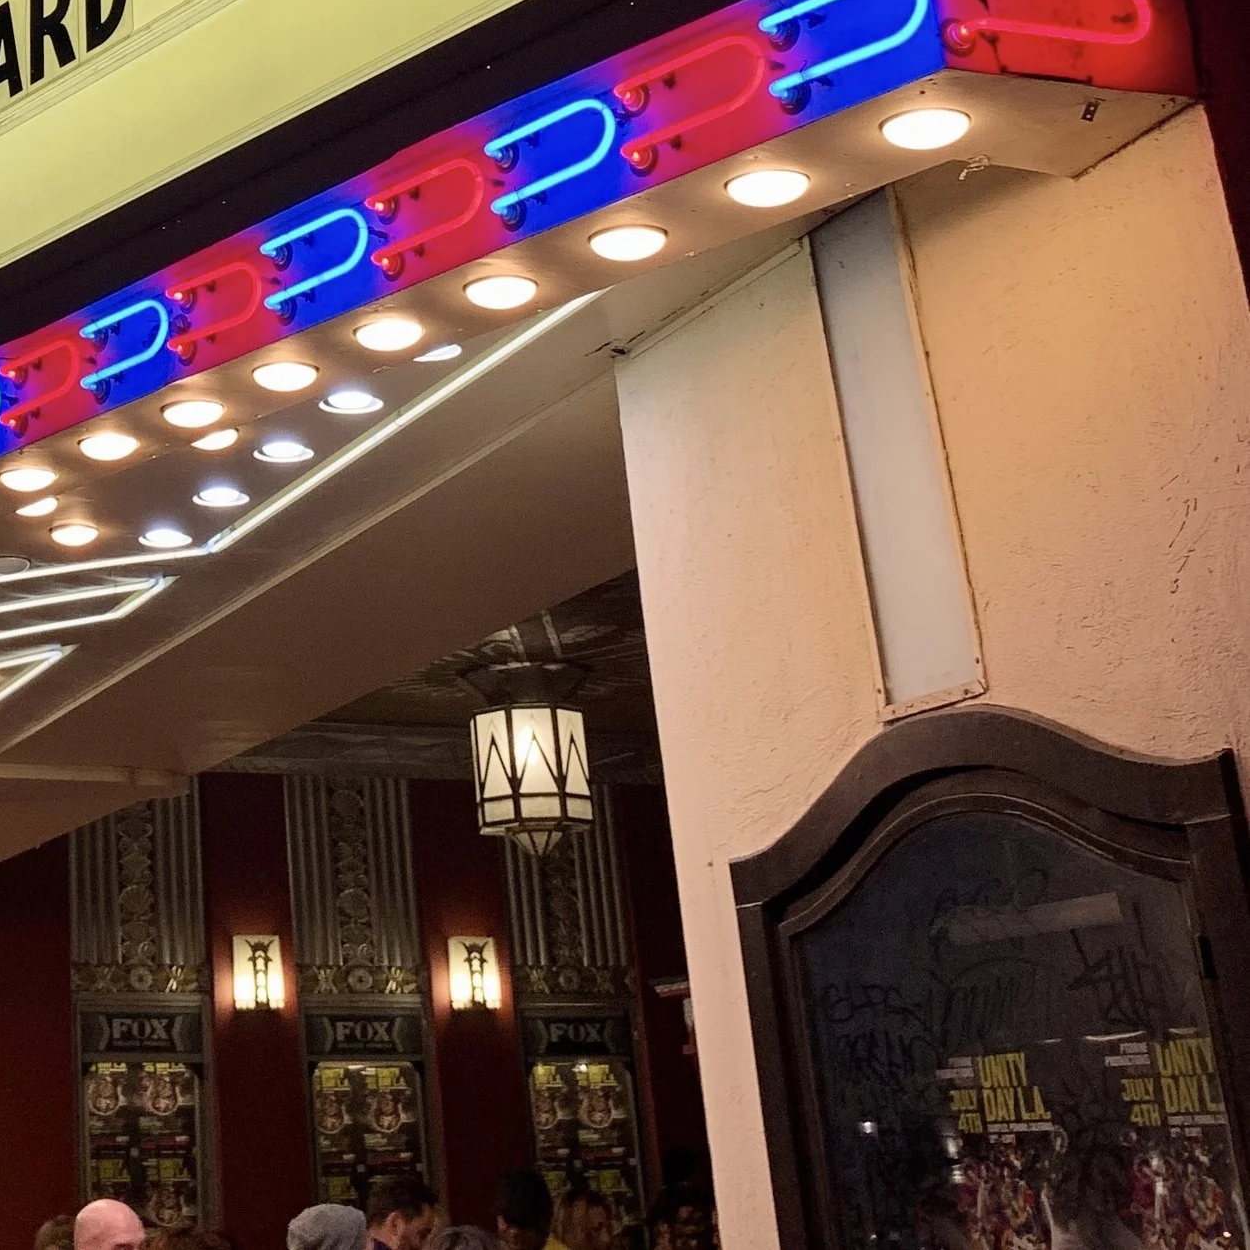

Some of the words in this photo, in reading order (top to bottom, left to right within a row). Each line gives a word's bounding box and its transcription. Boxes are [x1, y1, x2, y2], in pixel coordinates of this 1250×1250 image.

[112, 1018, 168, 1039] FOX
[336, 1021, 390, 1041] FOX
[550, 1023, 601, 1042] FOX
[1153, 1038, 1215, 1076] UNITY
[978, 1053, 1027, 1088] UNITY
[950, 1089, 977, 1111] JULY
[1121, 1077, 1154, 1101] JULY
[1161, 1075, 1200, 1112] DAY
[982, 1086, 1015, 1121] DAY
[1131, 1103, 1161, 1126] 4TH
[959, 1112, 983, 1134] 4TH
